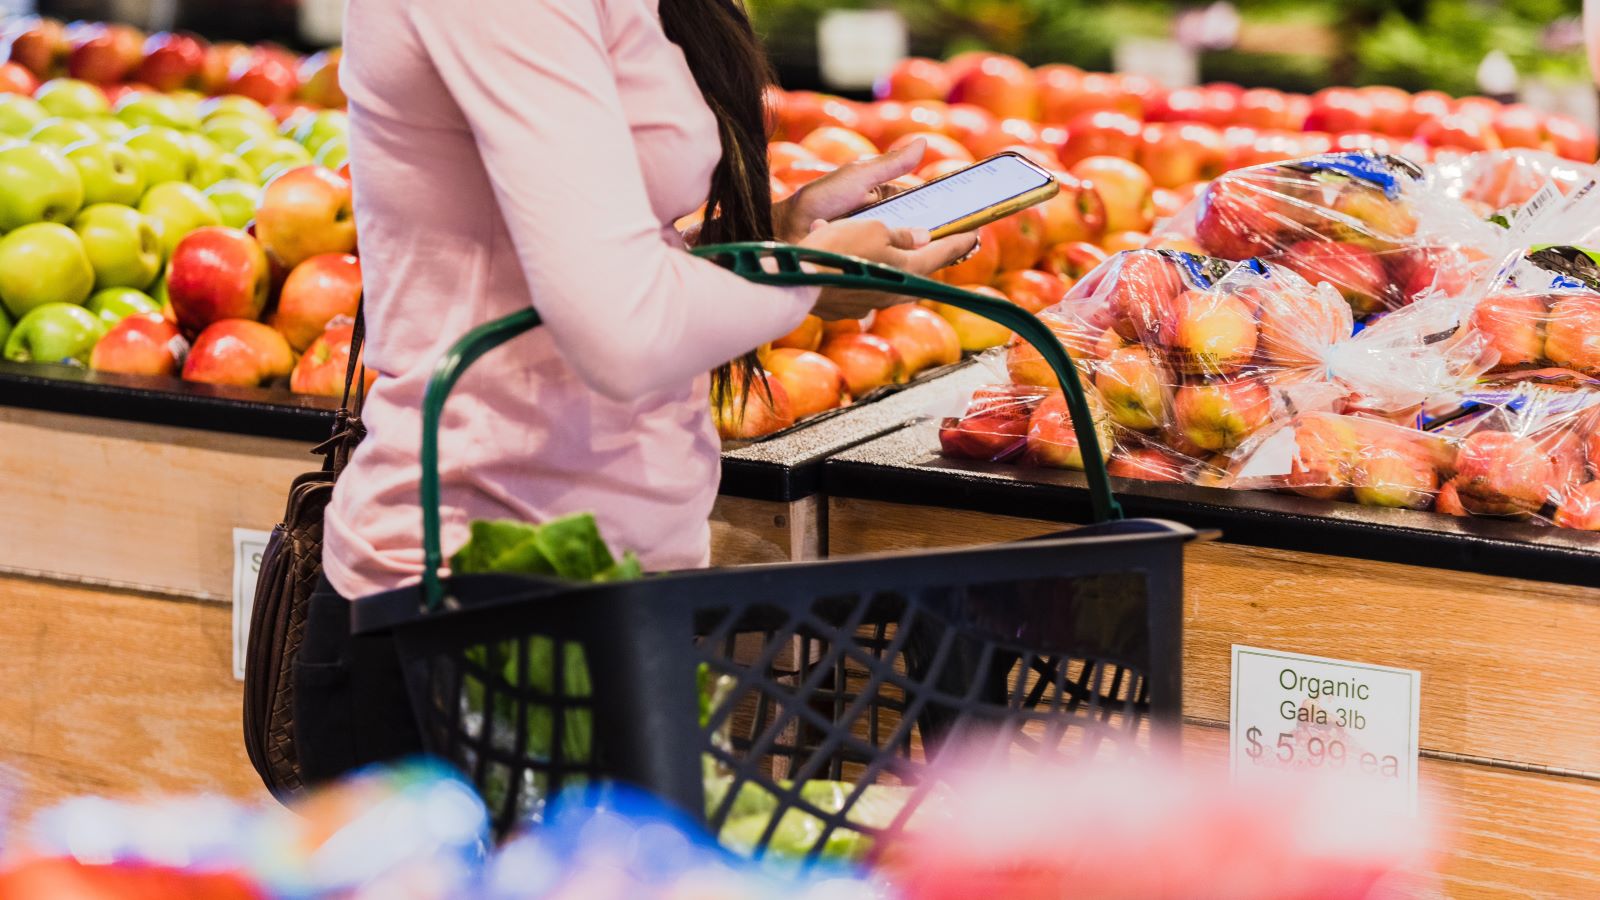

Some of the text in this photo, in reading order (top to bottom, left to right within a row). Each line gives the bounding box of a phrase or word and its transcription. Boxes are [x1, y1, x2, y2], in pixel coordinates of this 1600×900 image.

[1279, 668, 1369, 700] Organic
[1280, 700, 1366, 730] Gala 3lb
[1245, 725, 1398, 778] $ 5.99 ea
